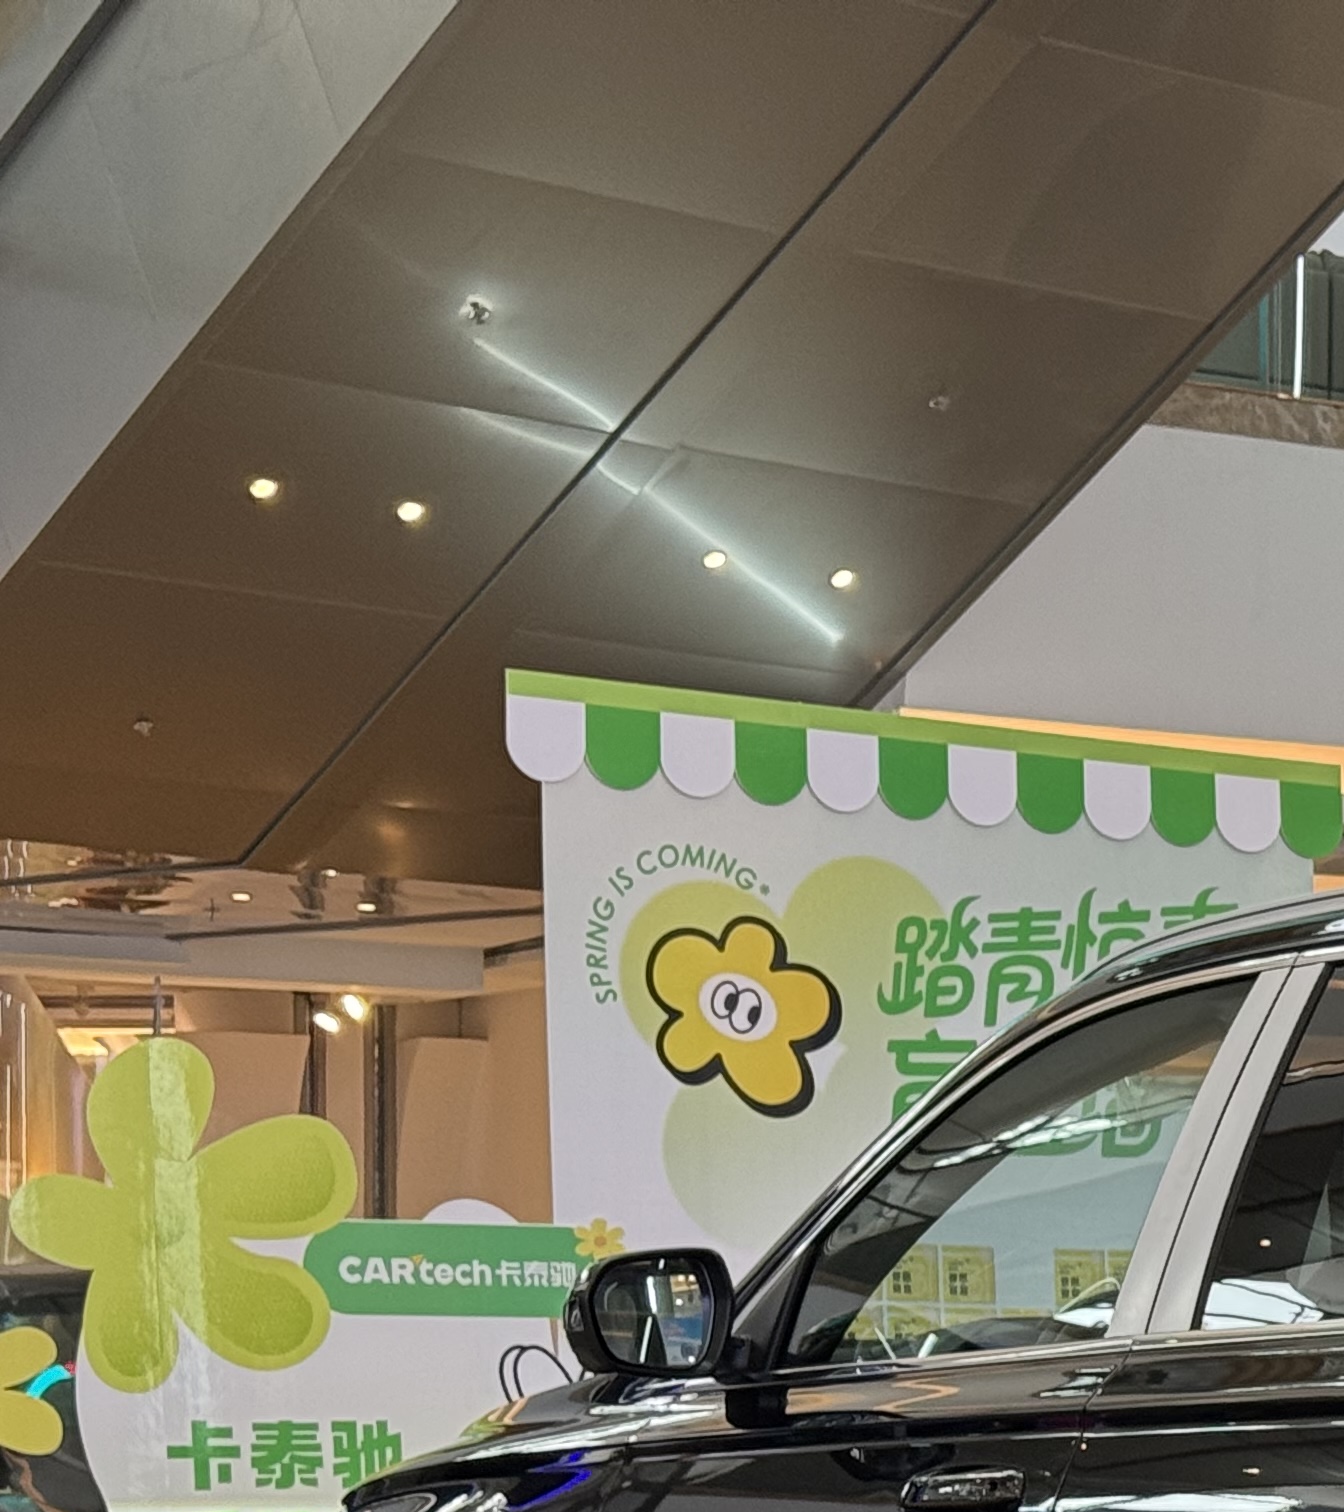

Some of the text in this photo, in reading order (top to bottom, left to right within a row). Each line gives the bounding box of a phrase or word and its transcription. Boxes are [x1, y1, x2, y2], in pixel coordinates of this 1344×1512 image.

[584, 842, 758, 1005] SPRING IS COMING
[338, 1255, 493, 1287] CARtech
[166, 1419, 403, 1491] 卡泰驰
